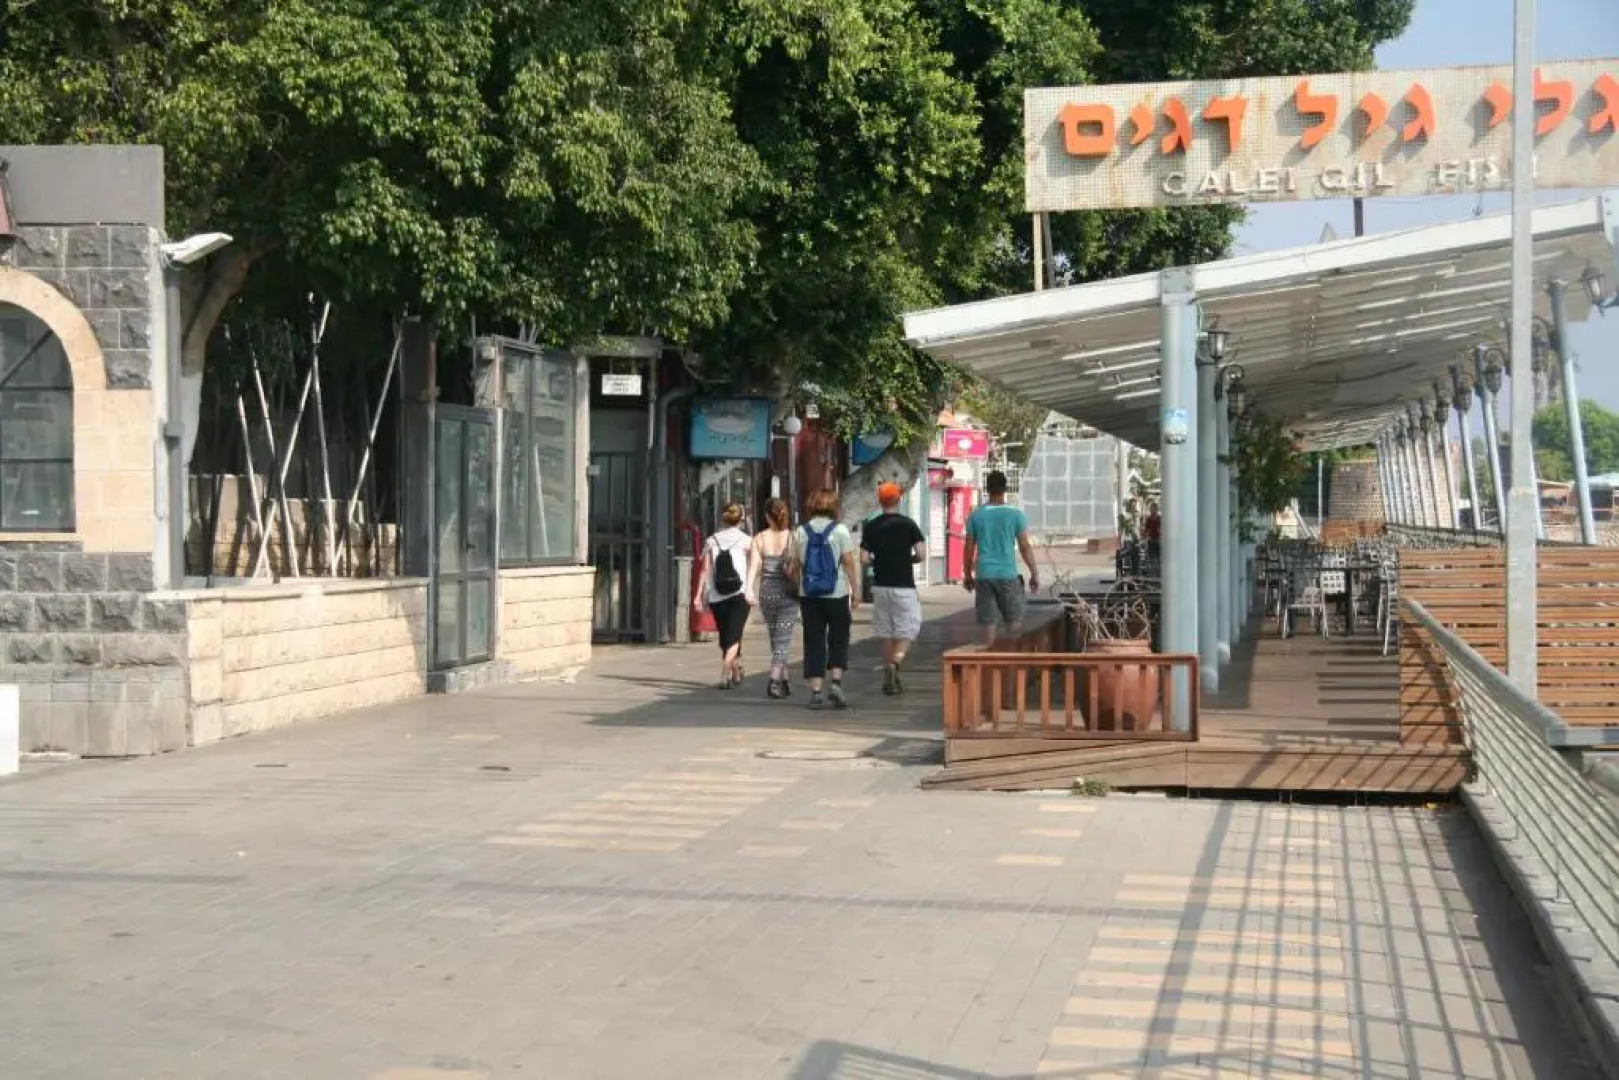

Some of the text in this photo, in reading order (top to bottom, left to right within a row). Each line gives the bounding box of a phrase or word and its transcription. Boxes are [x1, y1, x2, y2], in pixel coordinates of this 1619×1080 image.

[1059, 67, 1619, 157] גלי גיל דגים
